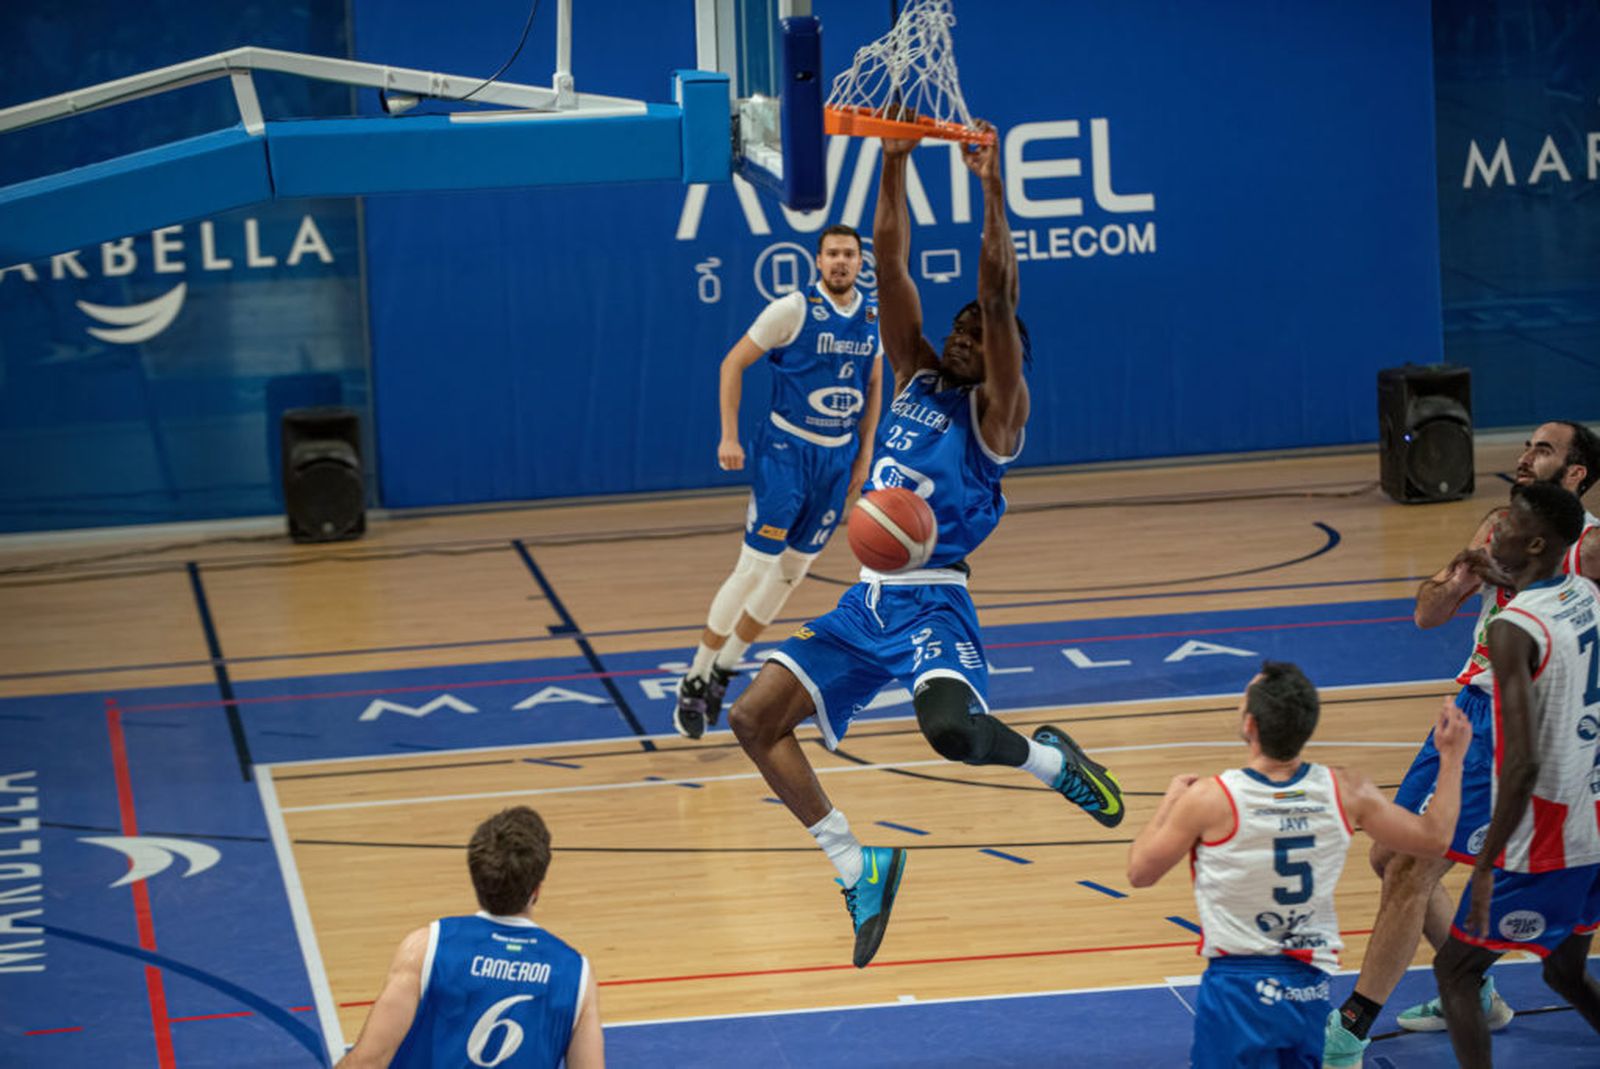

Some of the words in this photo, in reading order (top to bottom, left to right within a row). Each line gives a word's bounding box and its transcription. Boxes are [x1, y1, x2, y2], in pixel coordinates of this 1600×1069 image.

[981, 221, 1156, 262] ELECOM
[885, 424, 919, 451] 25
[1272, 834, 1316, 906] 5
[470, 955, 551, 984] CAMERON
[466, 994, 535, 1068] 6
